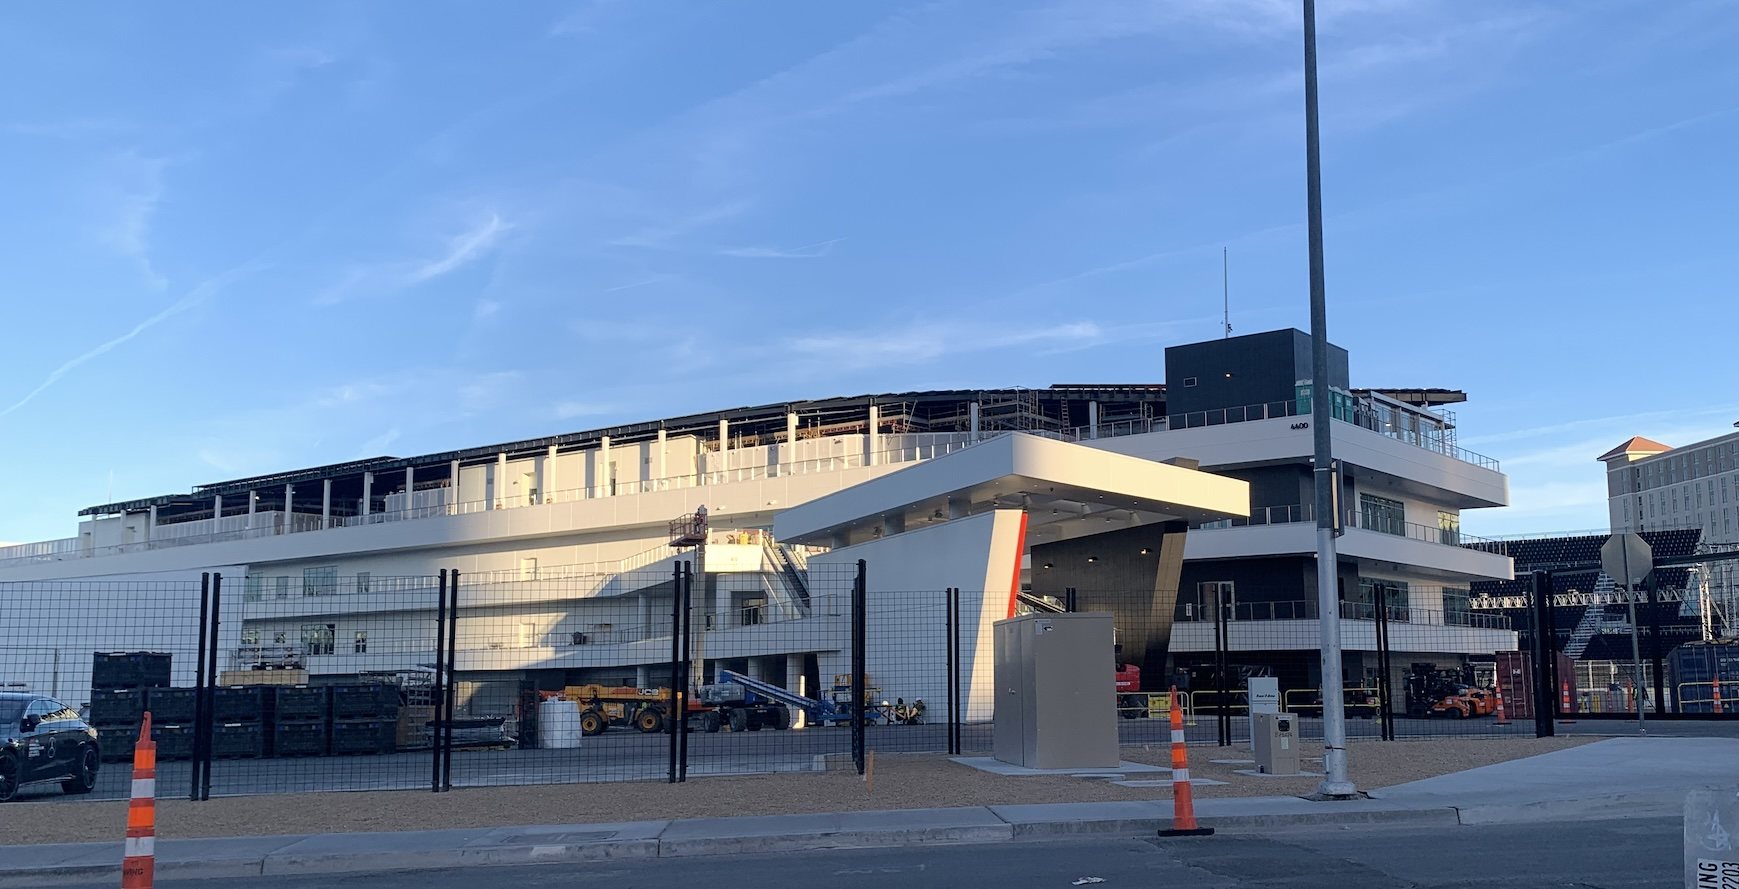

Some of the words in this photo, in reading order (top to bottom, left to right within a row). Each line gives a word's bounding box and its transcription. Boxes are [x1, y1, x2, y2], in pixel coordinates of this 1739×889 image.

[1290, 422, 1309, 430] 4400
[638, 688, 659, 696] JCB
[1698, 862, 1718, 889] ING
